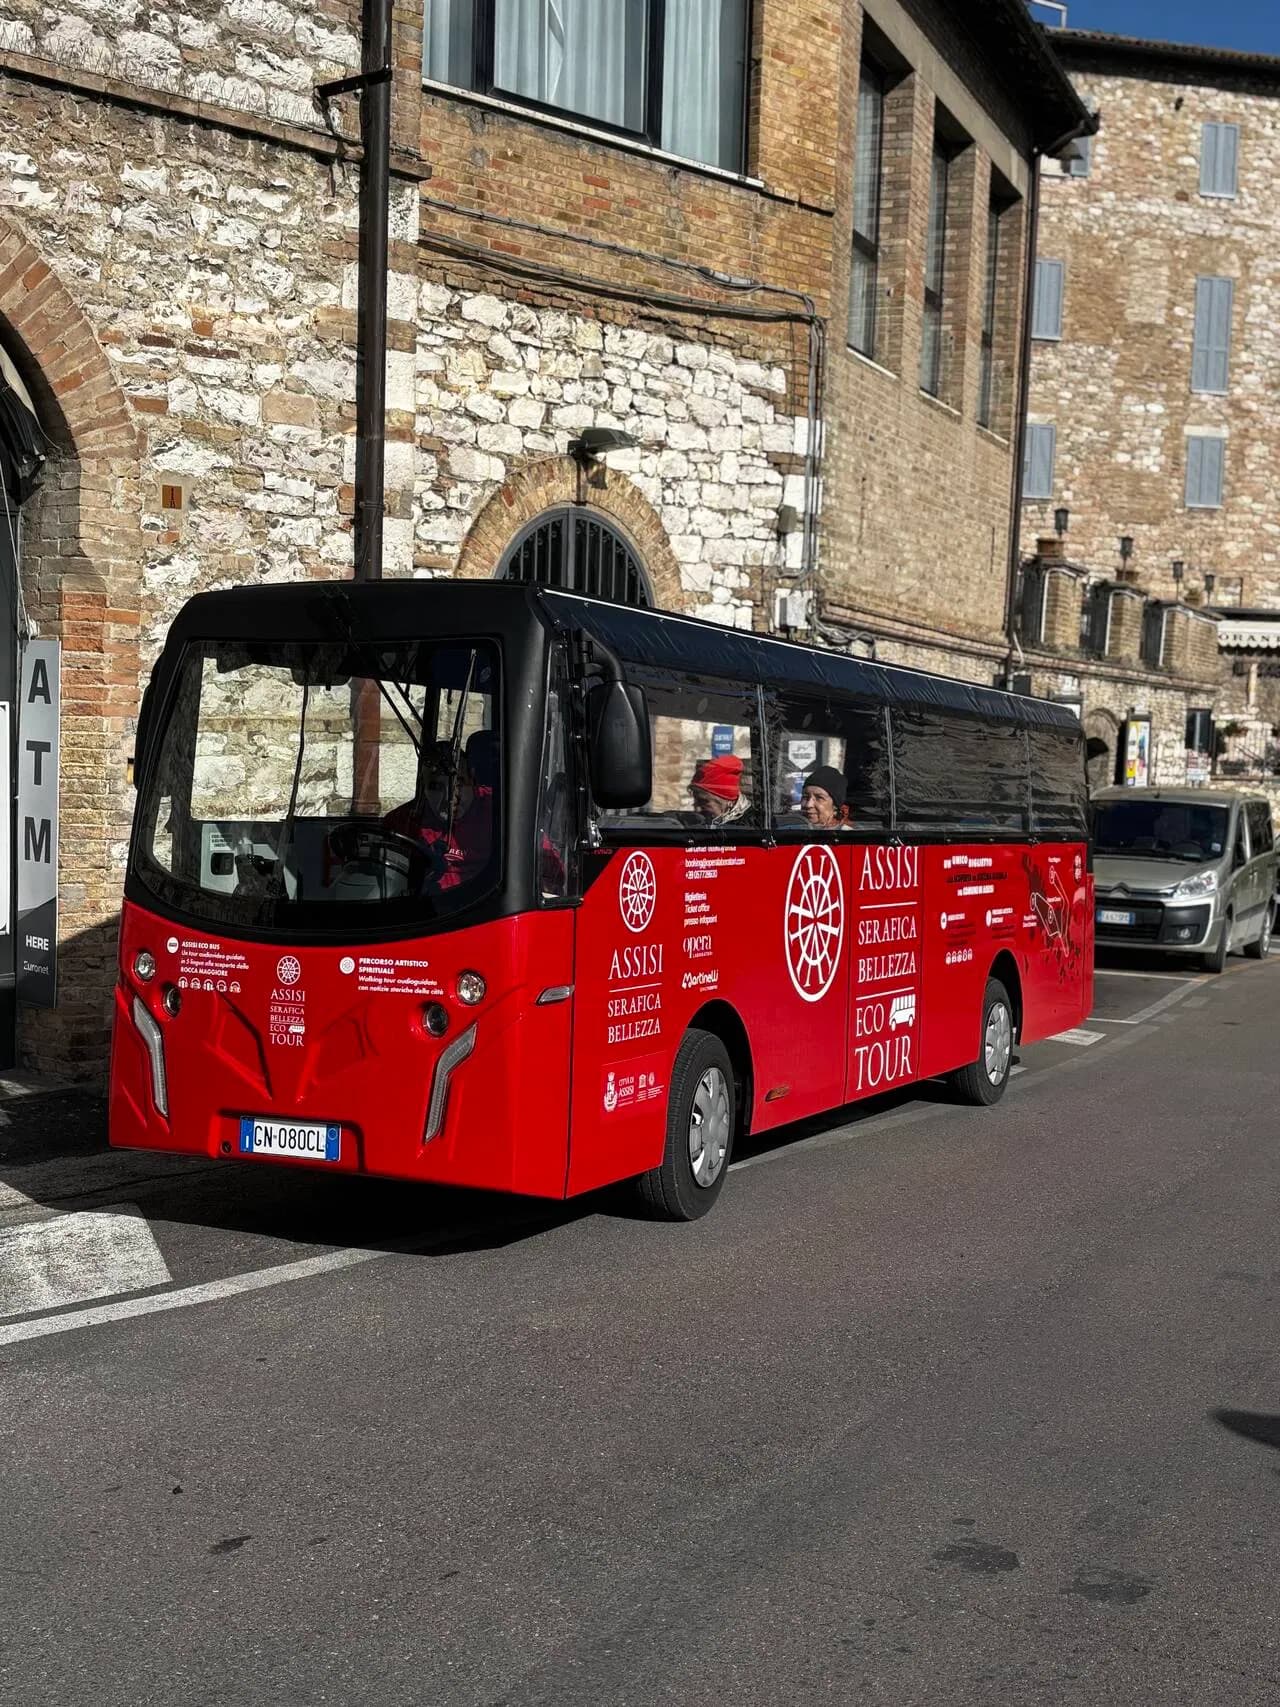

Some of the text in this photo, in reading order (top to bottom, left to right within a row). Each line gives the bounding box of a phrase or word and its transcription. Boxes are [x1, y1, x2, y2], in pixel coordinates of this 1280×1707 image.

[1218, 633, 1280, 642] ORAN
[24, 659, 52, 863] ATM
[859, 845, 919, 891] ASSISI
[684, 904, 698, 914] Ticket
[858, 915, 917, 946] SERAFICA
[25, 934, 49, 951] HERE
[682, 935, 712, 958] opera
[23, 960, 49, 975] Euronet
[359, 957, 428, 968] PERCORSO ARTISTICO
[608, 943, 664, 981] ASSISI
[857, 951, 917, 983] BELLEZZA
[181, 966, 228, 977] ROCCA MAGGIORE
[358, 967, 395, 975] SPIRITUALE
[358, 975, 383, 984] Walking
[681, 969, 719, 989] Martinelli
[270, 988, 306, 1002] ASSISI
[369, 984, 389, 992] notizie
[270, 1005, 305, 1015] SERAFICA
[608, 992, 662, 1018] SERAFICA
[270, 1014, 305, 1024] BELLEZZA
[856, 1003, 885, 1037] ECO
[270, 1023, 286, 1032] ECO
[607, 1017, 661, 1044] BELLEZZA
[269, 1032, 305, 1047] TOUR
[855, 1035, 913, 1091] TOUR
